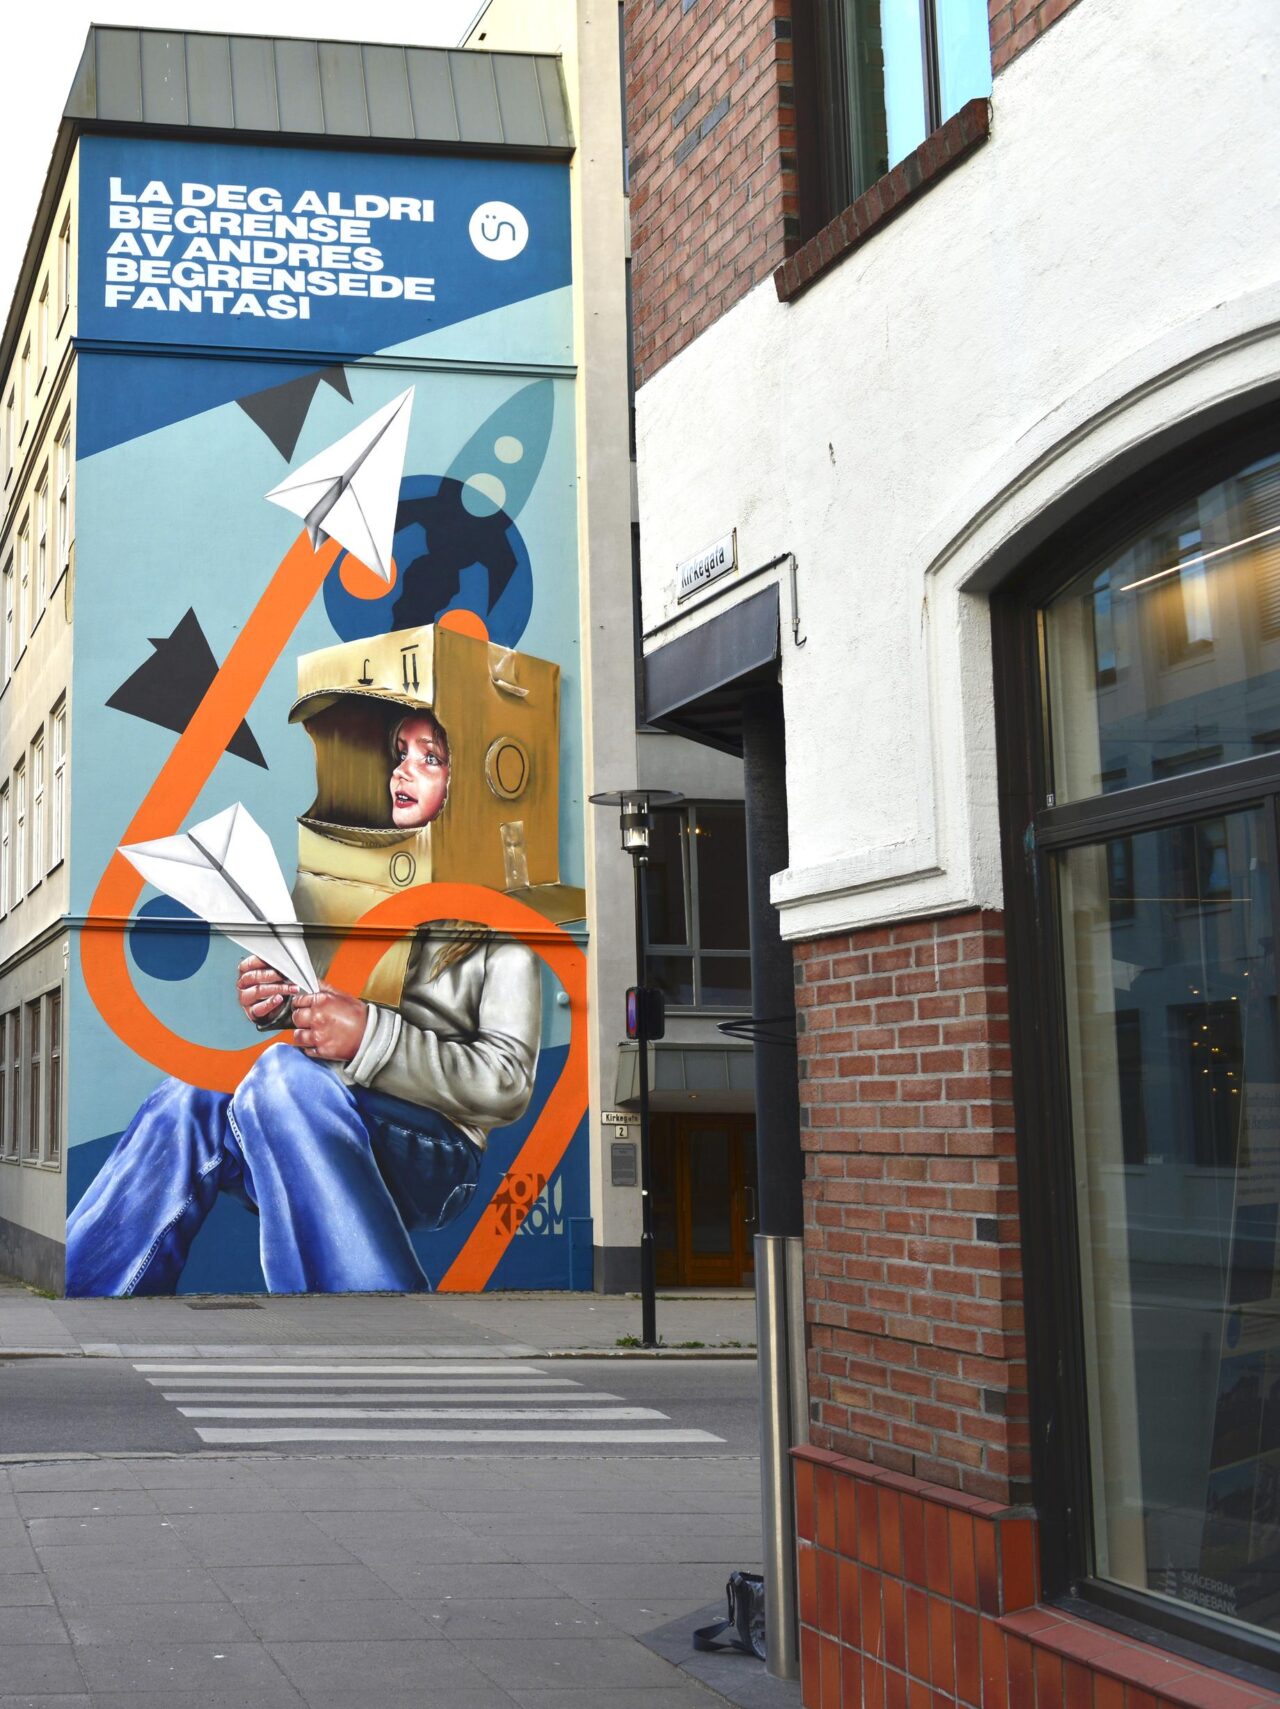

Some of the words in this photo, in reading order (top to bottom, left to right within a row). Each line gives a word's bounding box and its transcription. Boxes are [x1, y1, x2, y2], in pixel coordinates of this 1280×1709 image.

[109, 176, 174, 205] LA
[181, 182, 283, 213] DEG
[291, 190, 435, 223] ALDRI
[109, 204, 371, 244] BEGRENSE
[106, 231, 174, 258] AV
[181, 236, 385, 273] ANDRES
[105, 256, 436, 302] BEGRENSEDE
[104, 284, 310, 320] FANTASI
[681, 545, 725, 589] Kirkegata
[618, 1127, 625, 1137] 2
[1182, 1587, 1238, 1617] SPAREBANK
